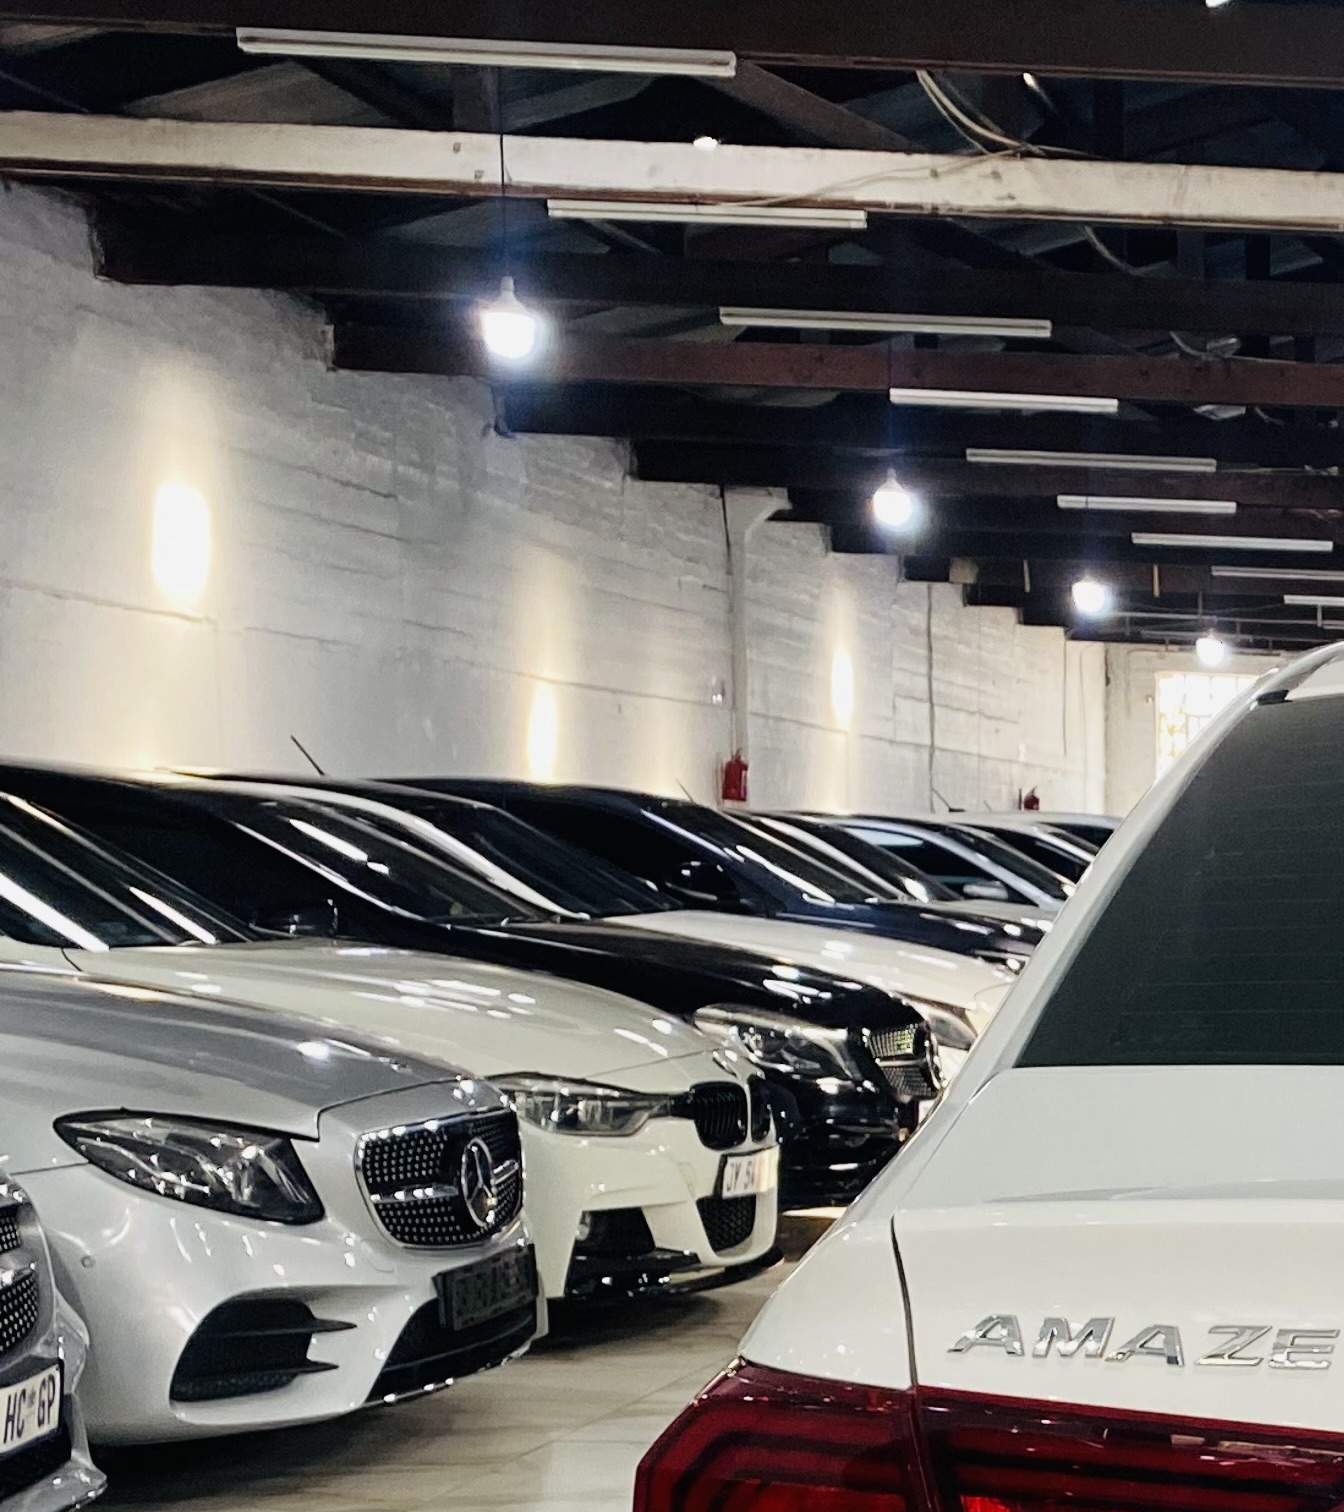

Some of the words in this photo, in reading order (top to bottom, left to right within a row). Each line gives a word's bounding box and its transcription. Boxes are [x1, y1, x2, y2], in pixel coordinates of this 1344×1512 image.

[946, 1313, 1341, 1368] AMAZE
[3, 1388, 27, 1444] HC
[37, 1373, 56, 1428] GP
